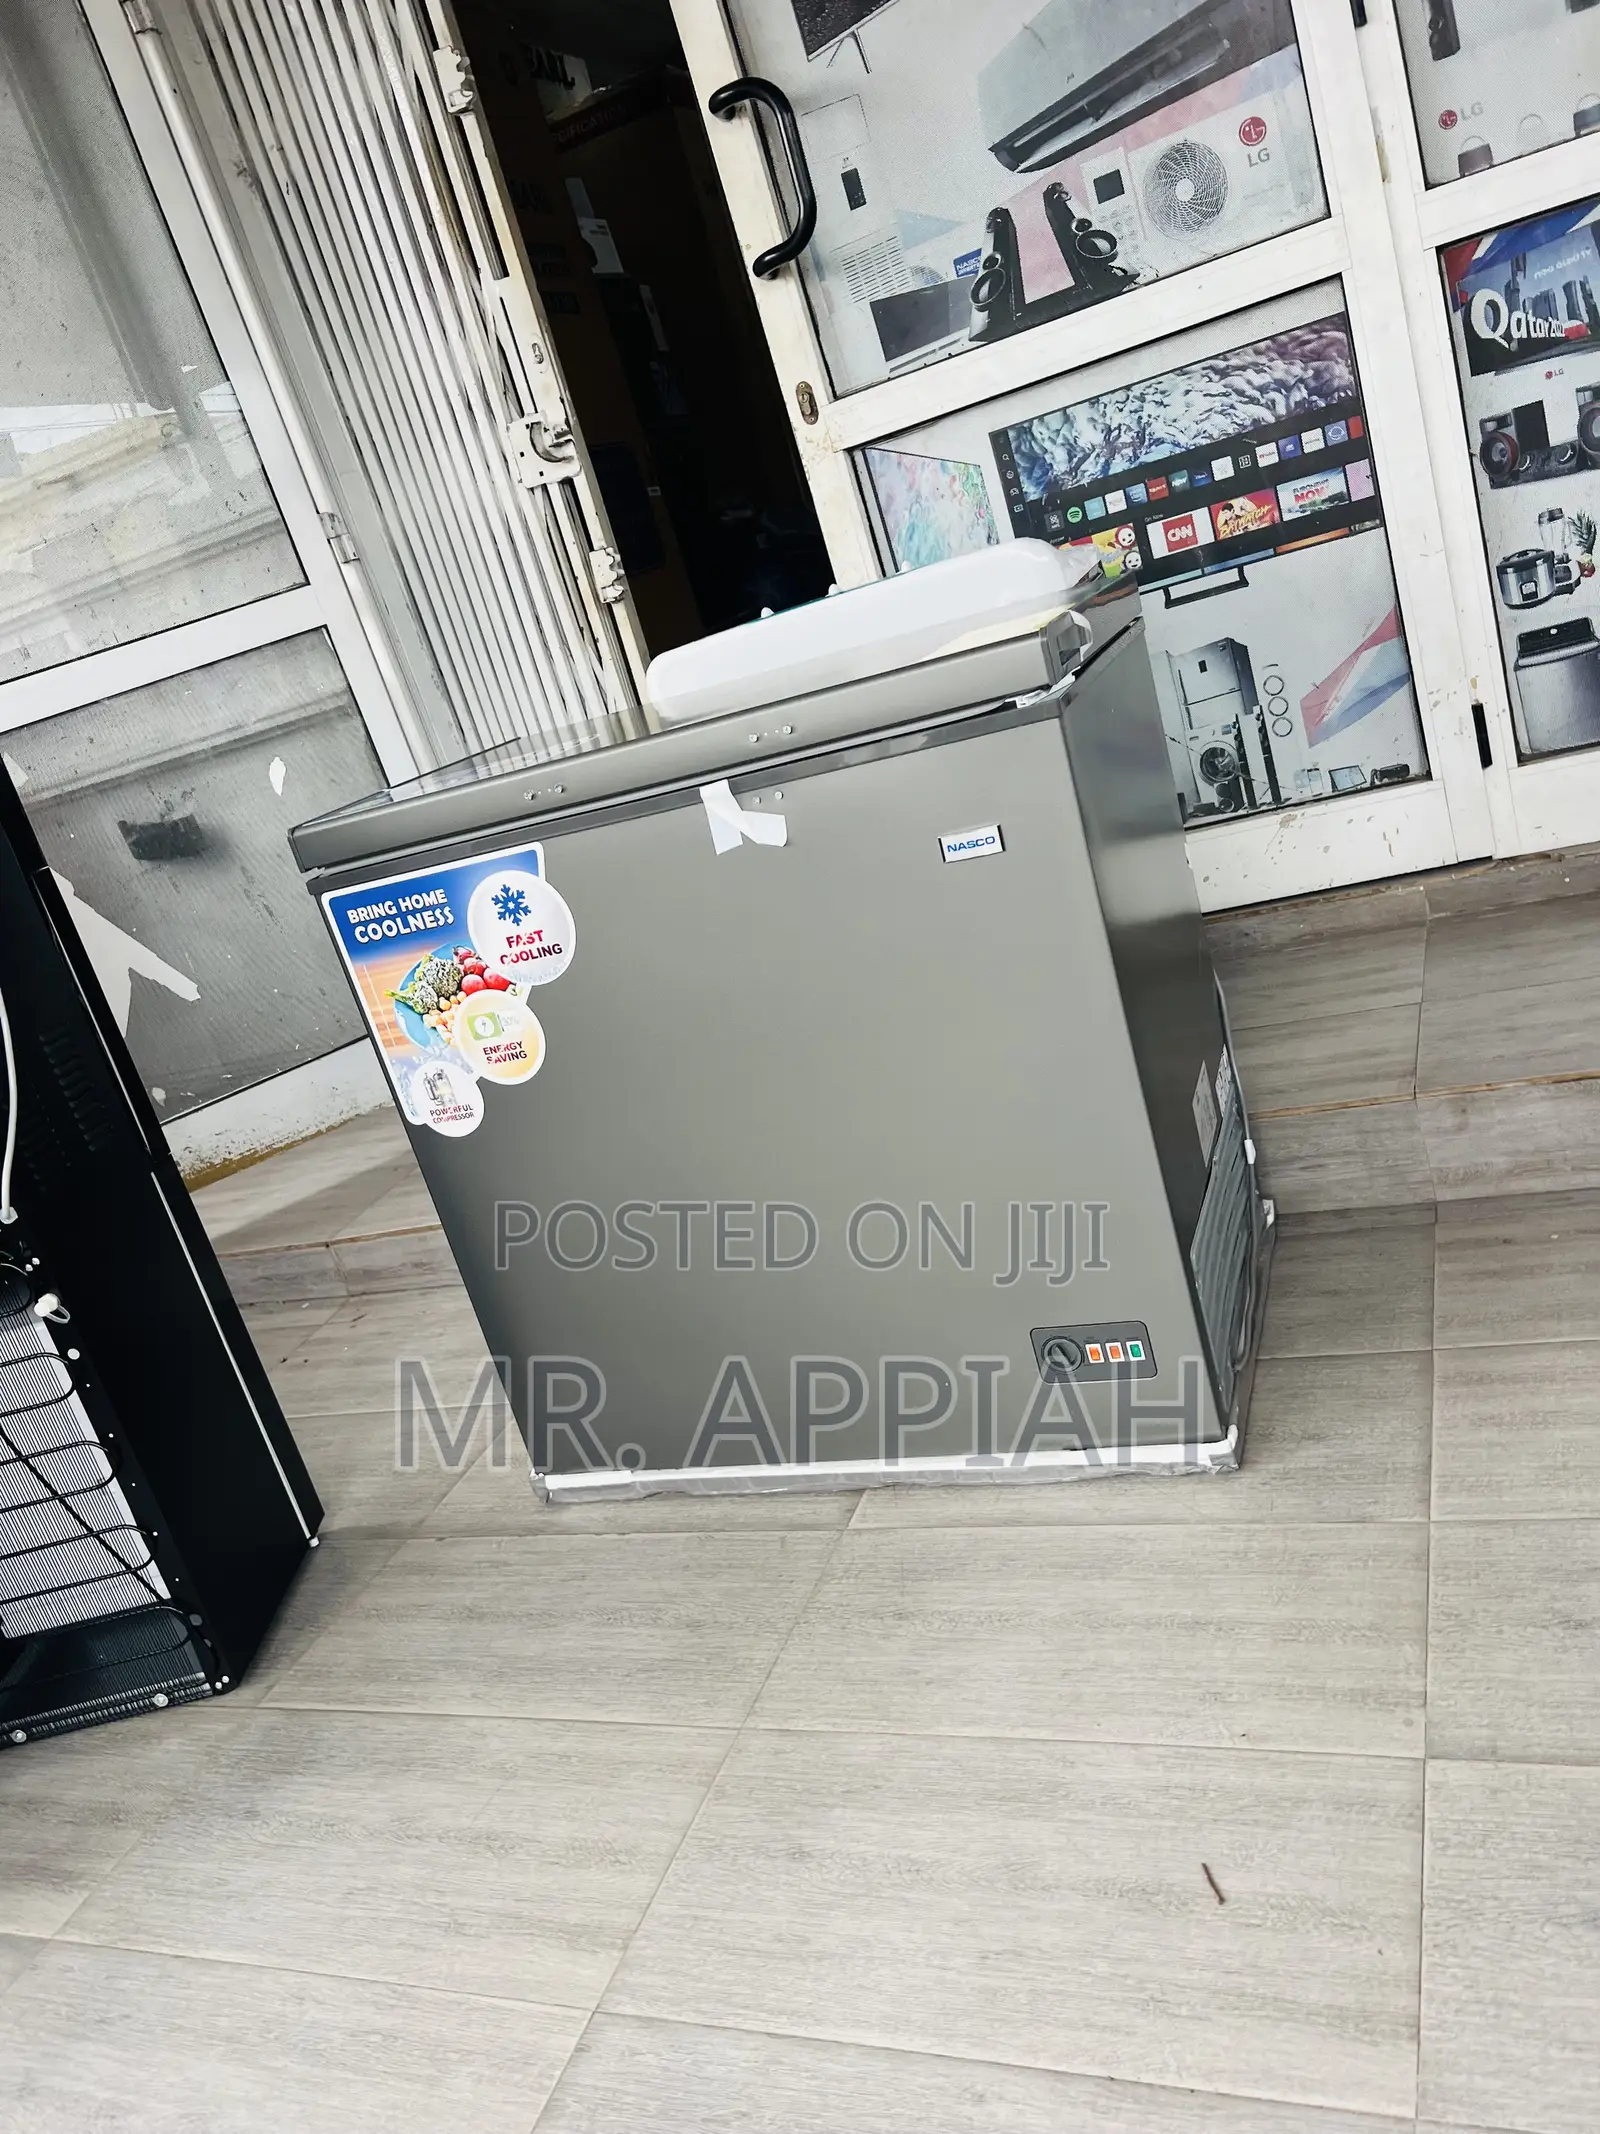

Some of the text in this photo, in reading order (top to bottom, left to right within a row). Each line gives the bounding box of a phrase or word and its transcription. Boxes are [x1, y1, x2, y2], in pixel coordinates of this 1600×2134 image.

[1461, 101, 1483, 120] LG
[1247, 147, 1270, 168] LG
[956, 255, 982, 271] NASC
[1167, 523, 1193, 542] CNN
[947, 836, 995, 852] NASCO
[346, 888, 448, 924] BRING HOME
[354, 906, 455, 943] COOLNESS
[505, 929, 543, 948] FAST
[500, 943, 563, 965] COOLING
[482, 1041, 523, 1056] ENERGY
[486, 1050, 528, 1065] SAVING
